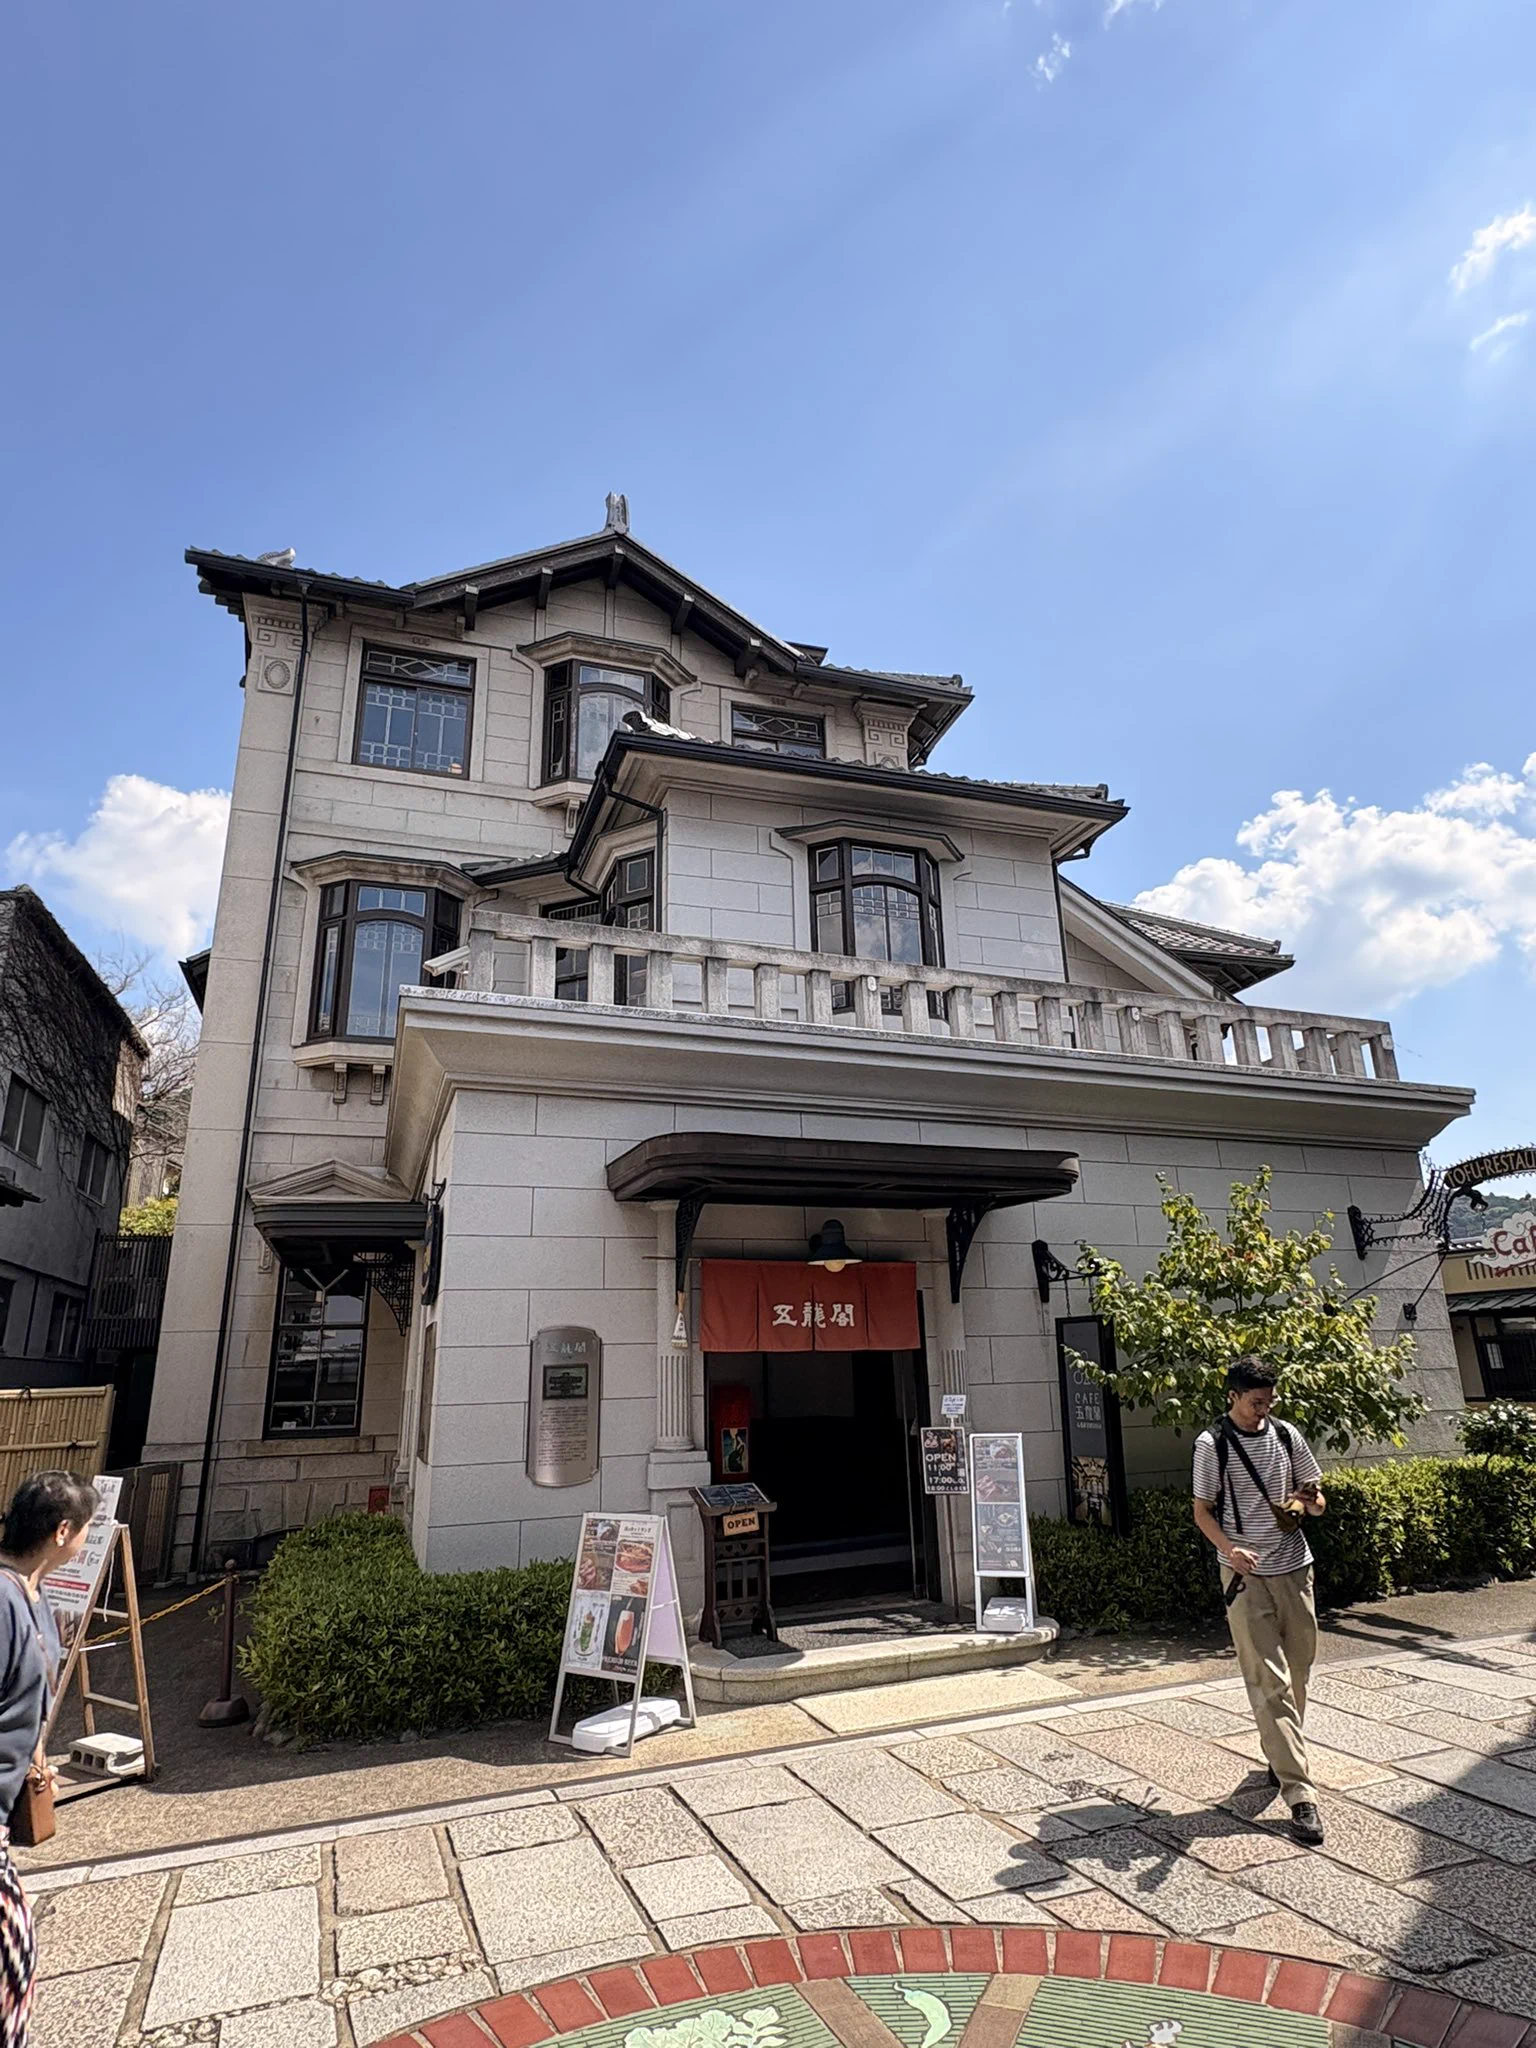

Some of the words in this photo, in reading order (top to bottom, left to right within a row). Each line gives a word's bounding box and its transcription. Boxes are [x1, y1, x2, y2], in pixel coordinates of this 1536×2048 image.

[1447, 1151, 1535, 1187] TOFU-RESTAU
[772, 1301, 855, 1328] 五龍閣
[1075, 1392, 1100, 1405] CAFE
[925, 1452, 956, 1462] OPEN
[727, 1517, 756, 1529] OPEN
